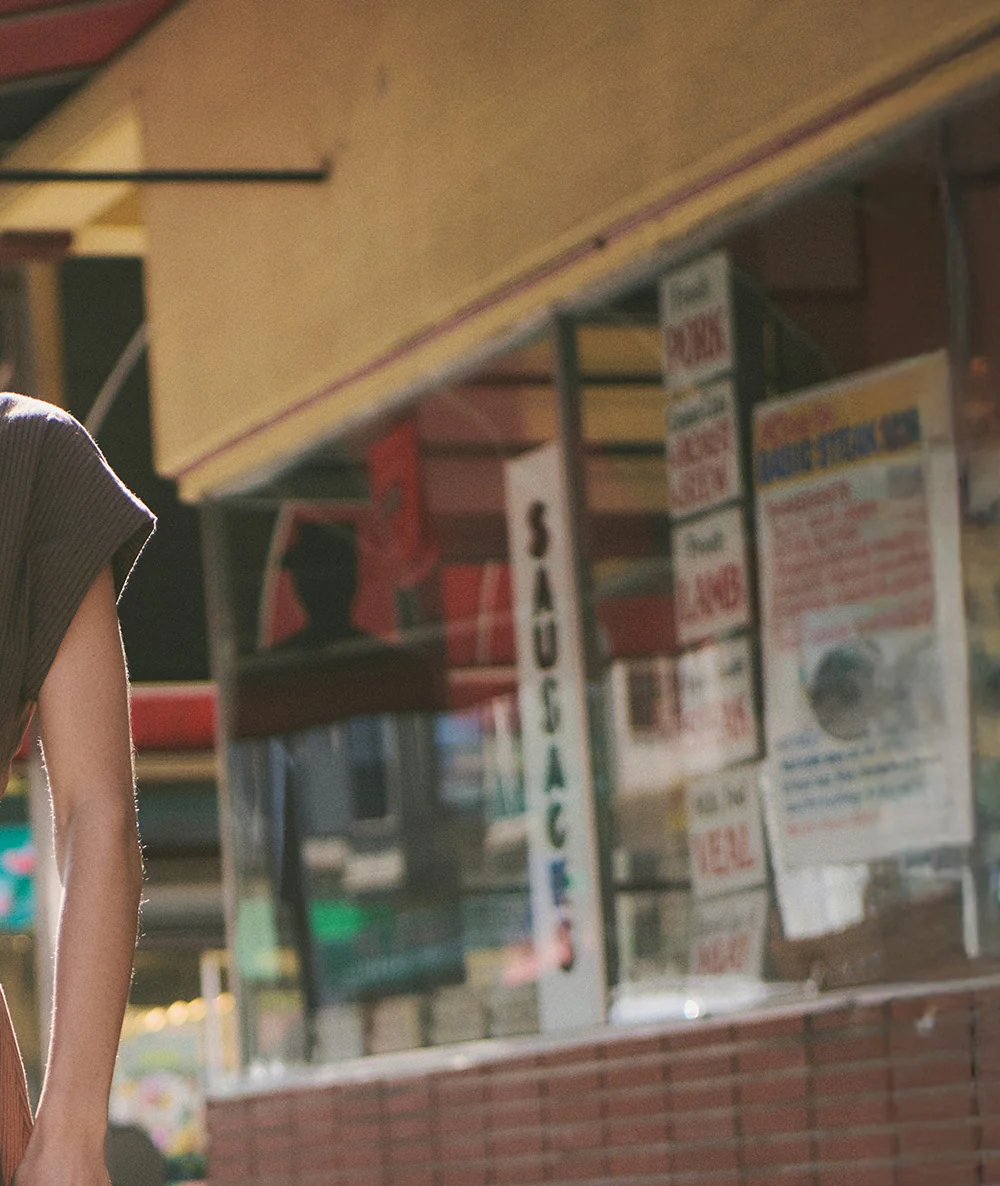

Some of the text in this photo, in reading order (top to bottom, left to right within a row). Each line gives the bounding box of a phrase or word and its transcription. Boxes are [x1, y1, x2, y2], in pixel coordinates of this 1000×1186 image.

[676, 562, 742, 622] LAMB
[527, 500, 577, 973] SAUSAGES
[692, 822, 754, 876] VEAL
